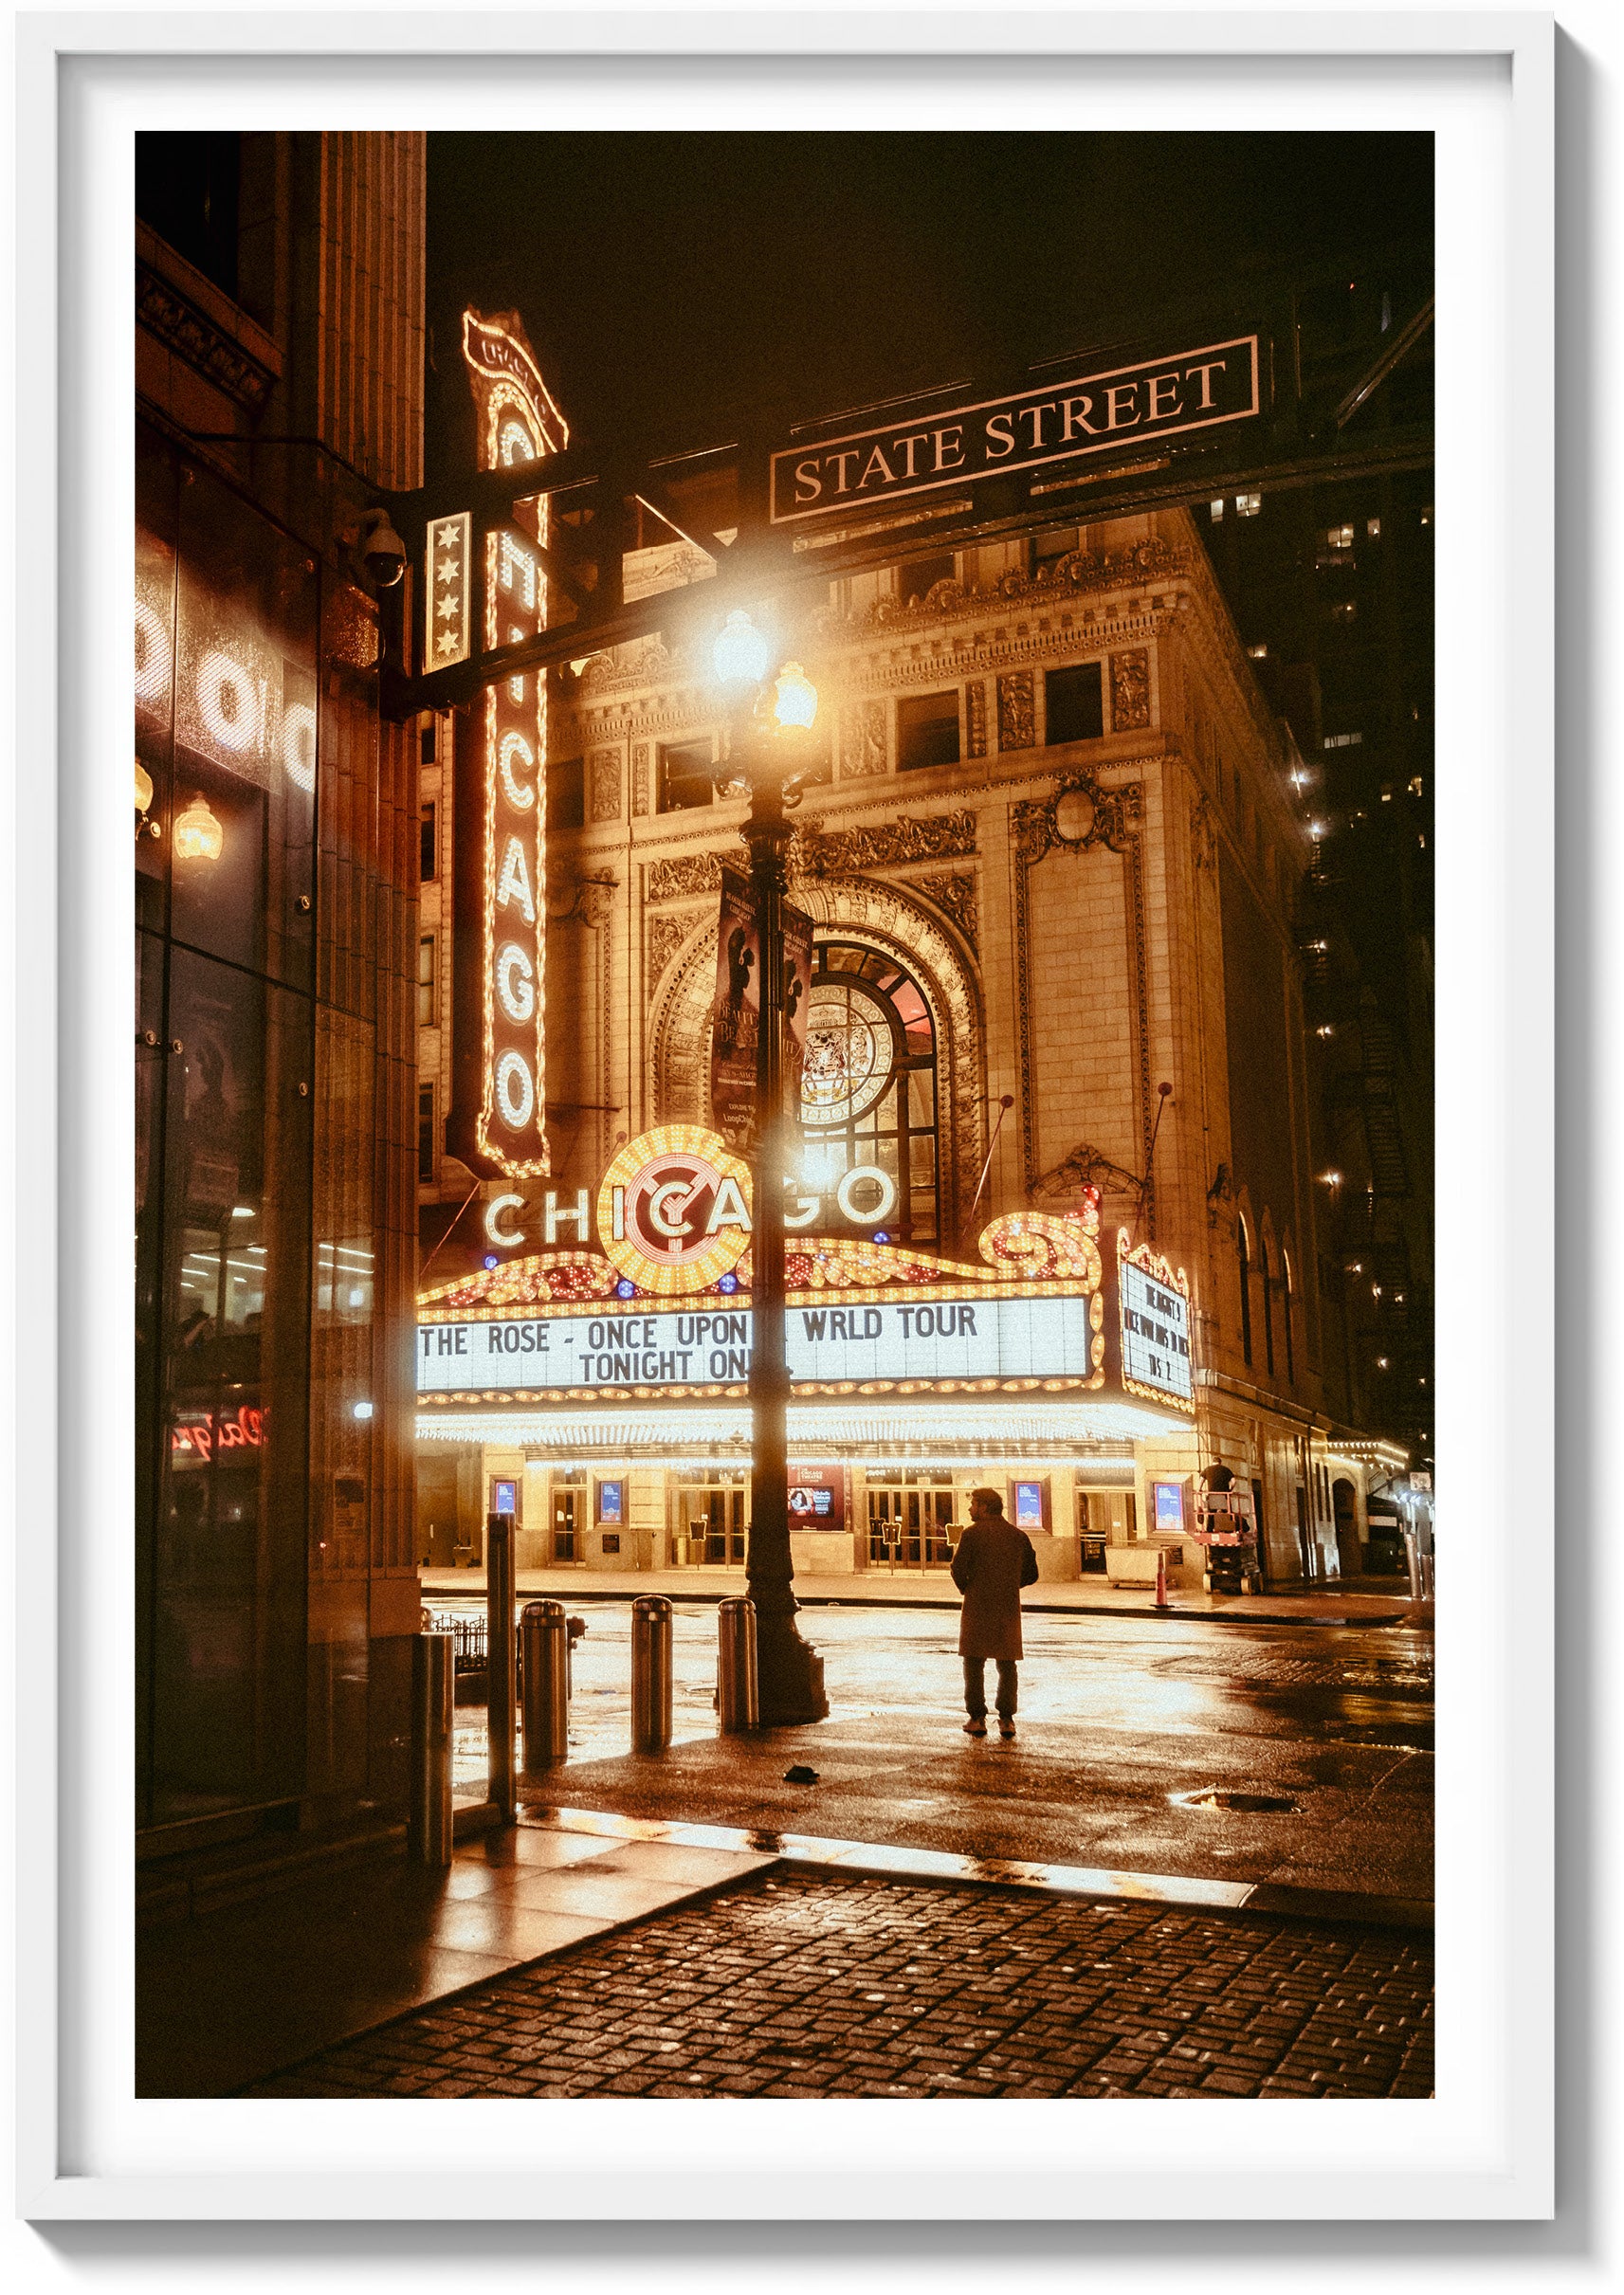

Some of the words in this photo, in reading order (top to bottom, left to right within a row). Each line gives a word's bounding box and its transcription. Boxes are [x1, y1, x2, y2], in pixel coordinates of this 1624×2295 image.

[794, 426, 965, 504] STATE
[985, 360, 1227, 460] STREET
[484, 1166, 894, 1247] CHICAGO
[420, 1327, 467, 1357] THE
[488, 1323, 550, 1354] ROSE
[588, 1318, 658, 1350] ONCE
[678, 1314, 747, 1345] UPON
[802, 1307, 883, 1341] WRLD
[897, 1304, 977, 1339] TOUR
[579, 1349, 692, 1382] TONIGHT
